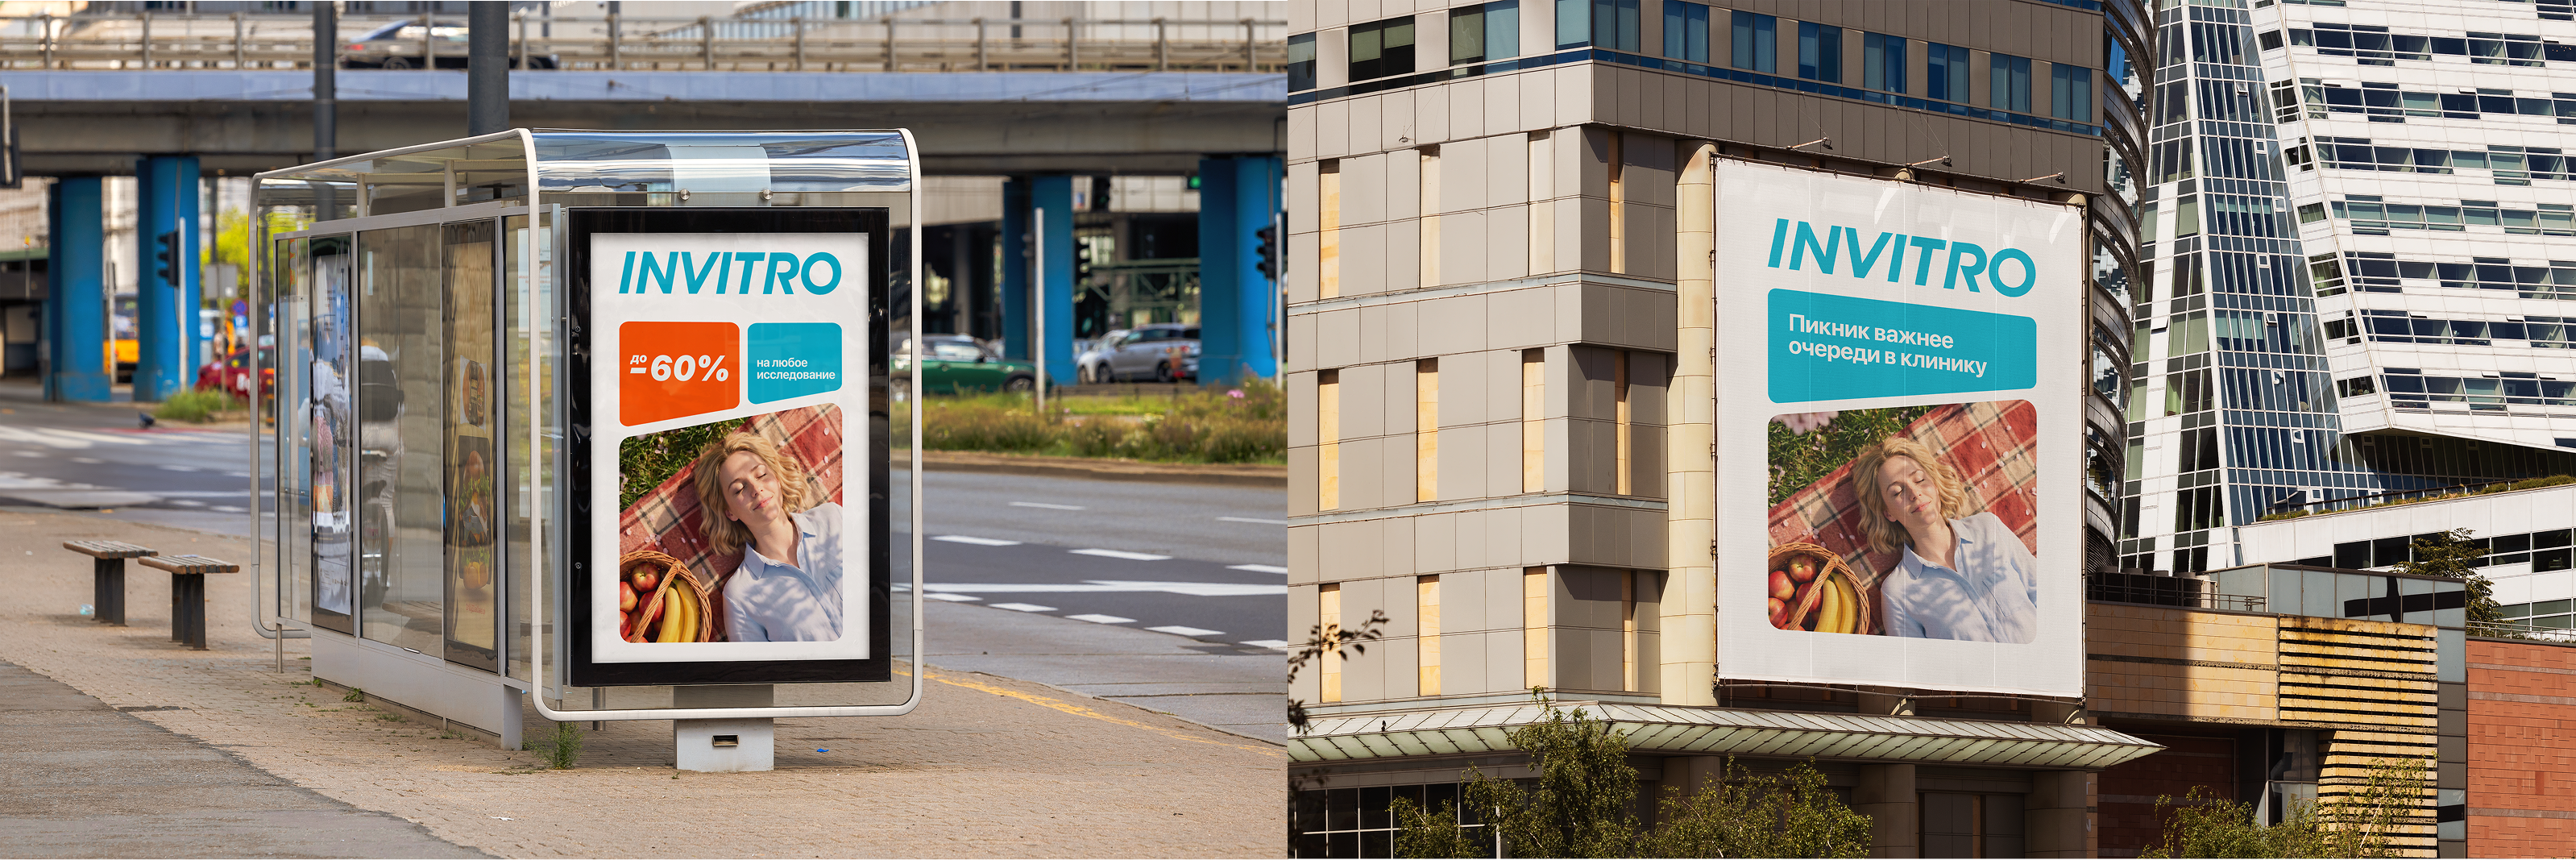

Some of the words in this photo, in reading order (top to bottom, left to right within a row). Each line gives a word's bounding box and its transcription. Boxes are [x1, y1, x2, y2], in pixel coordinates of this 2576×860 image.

[619, 251, 842, 296] INVITRO
[1768, 218, 2037, 298] INVITRO
[1789, 314, 1870, 340] Пикник
[1874, 327, 1954, 349] важнее
[629, 355, 648, 365] до
[757, 359, 770, 368] на
[771, 357, 808, 368] любое
[757, 372, 836, 381] исследование
[1789, 340, 1880, 365] очереди
[1885, 351, 1897, 365] в
[1901, 352, 1988, 378] клинику
